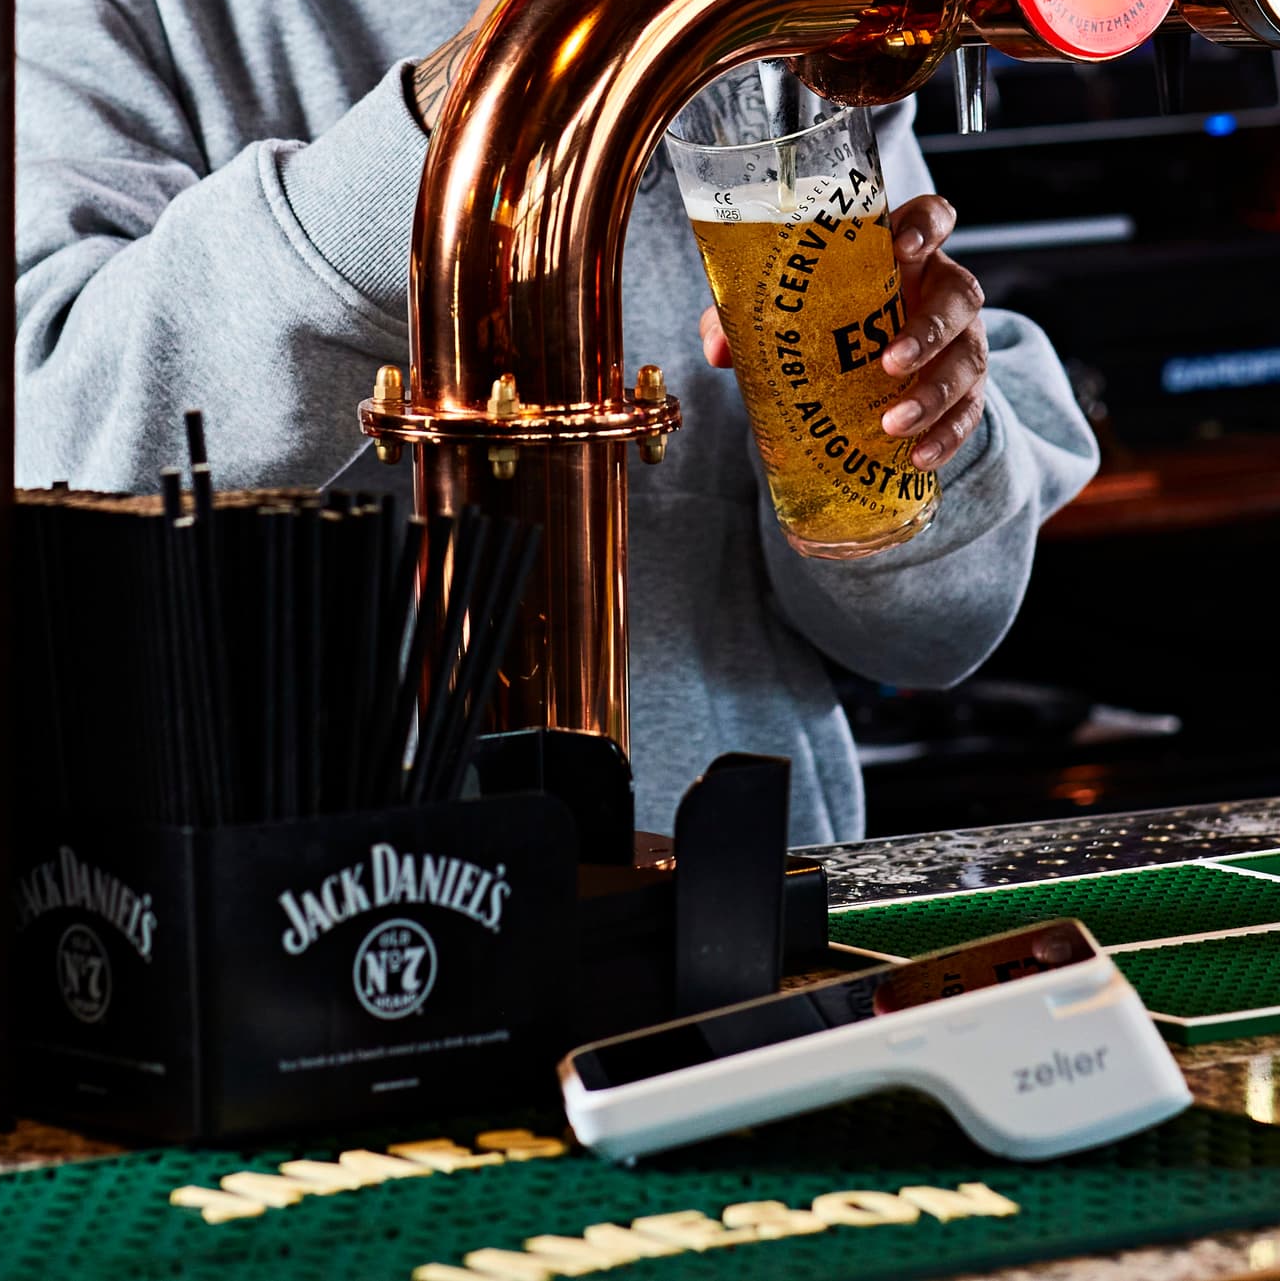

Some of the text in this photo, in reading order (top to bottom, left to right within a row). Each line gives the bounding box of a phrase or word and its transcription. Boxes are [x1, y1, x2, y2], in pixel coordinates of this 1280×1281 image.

[844, 216, 865, 243] DE
[753, 280, 768, 333] BERLIN
[774, 167, 868, 390] 1876 CERVEZA
[794, 400, 894, 494] AUGUST
[279, 862, 371, 955] JACK
[379, 930, 411, 947] OLD
